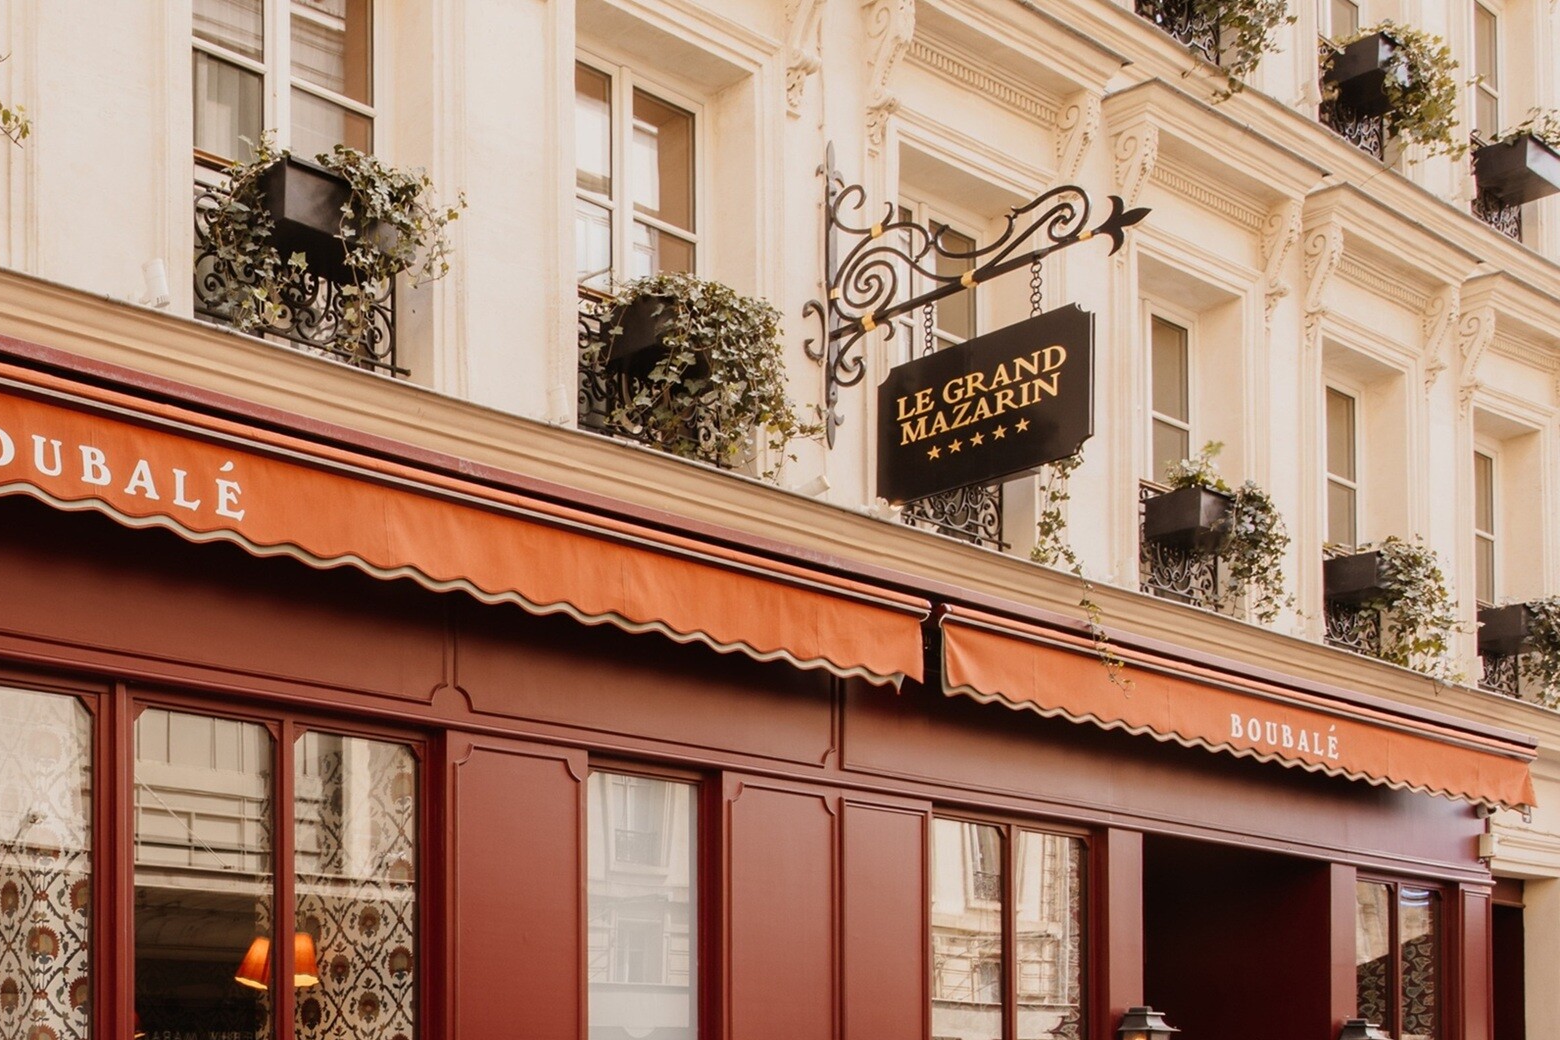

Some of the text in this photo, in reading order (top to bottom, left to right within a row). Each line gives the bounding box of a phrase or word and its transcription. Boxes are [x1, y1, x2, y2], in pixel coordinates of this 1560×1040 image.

[896, 344, 1068, 422] LE GRAND
[899, 371, 1062, 447] MAZARIN
[1229, 712, 1340, 761] BOUBALÉ
